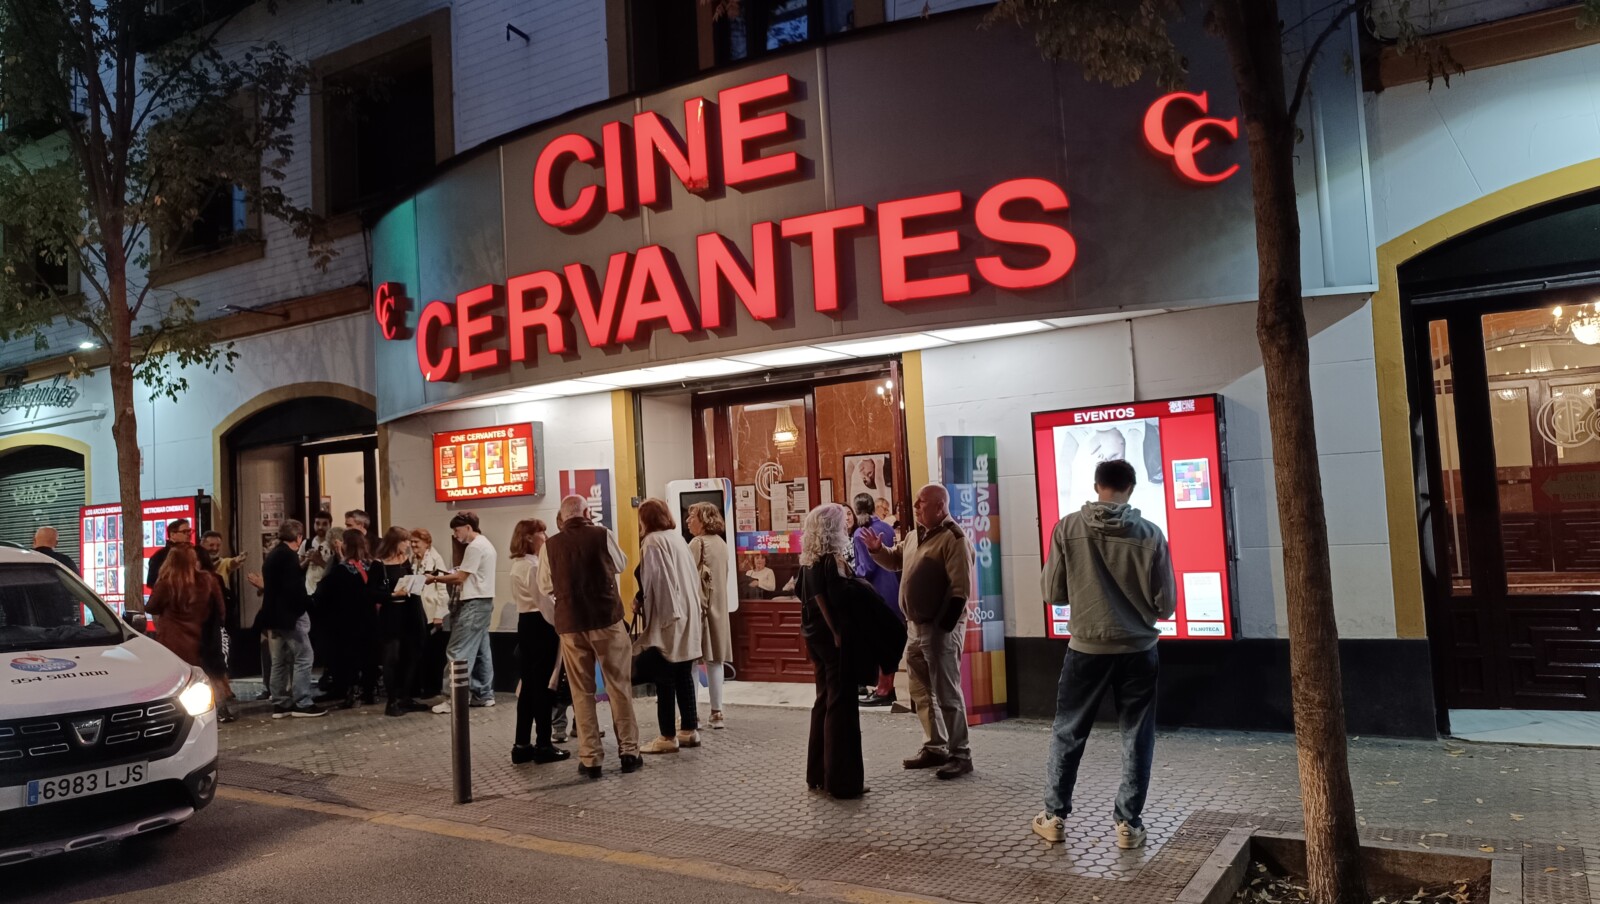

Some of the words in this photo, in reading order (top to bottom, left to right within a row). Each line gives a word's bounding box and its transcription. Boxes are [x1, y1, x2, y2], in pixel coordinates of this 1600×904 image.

[533, 73, 800, 231] CINE
[415, 177, 1078, 383] CERVANTES
[1074, 407, 1136, 423] EVENTOS
[450, 434, 466, 443] CINE
[467, 430, 506, 441] CERVANTES
[446, 488, 477, 497] TAQUILLA
[483, 486, 497, 494] BOX
[498, 484, 524, 493] OFFICE
[587, 484, 603, 526] villa
[972, 453, 990, 532] Sevilla
[976, 537, 992, 568] de
[11, 676, 42, 685] 954
[46, 672, 77, 680] 580
[42, 773, 98, 800] 6983
[105, 764, 144, 789] LJS
